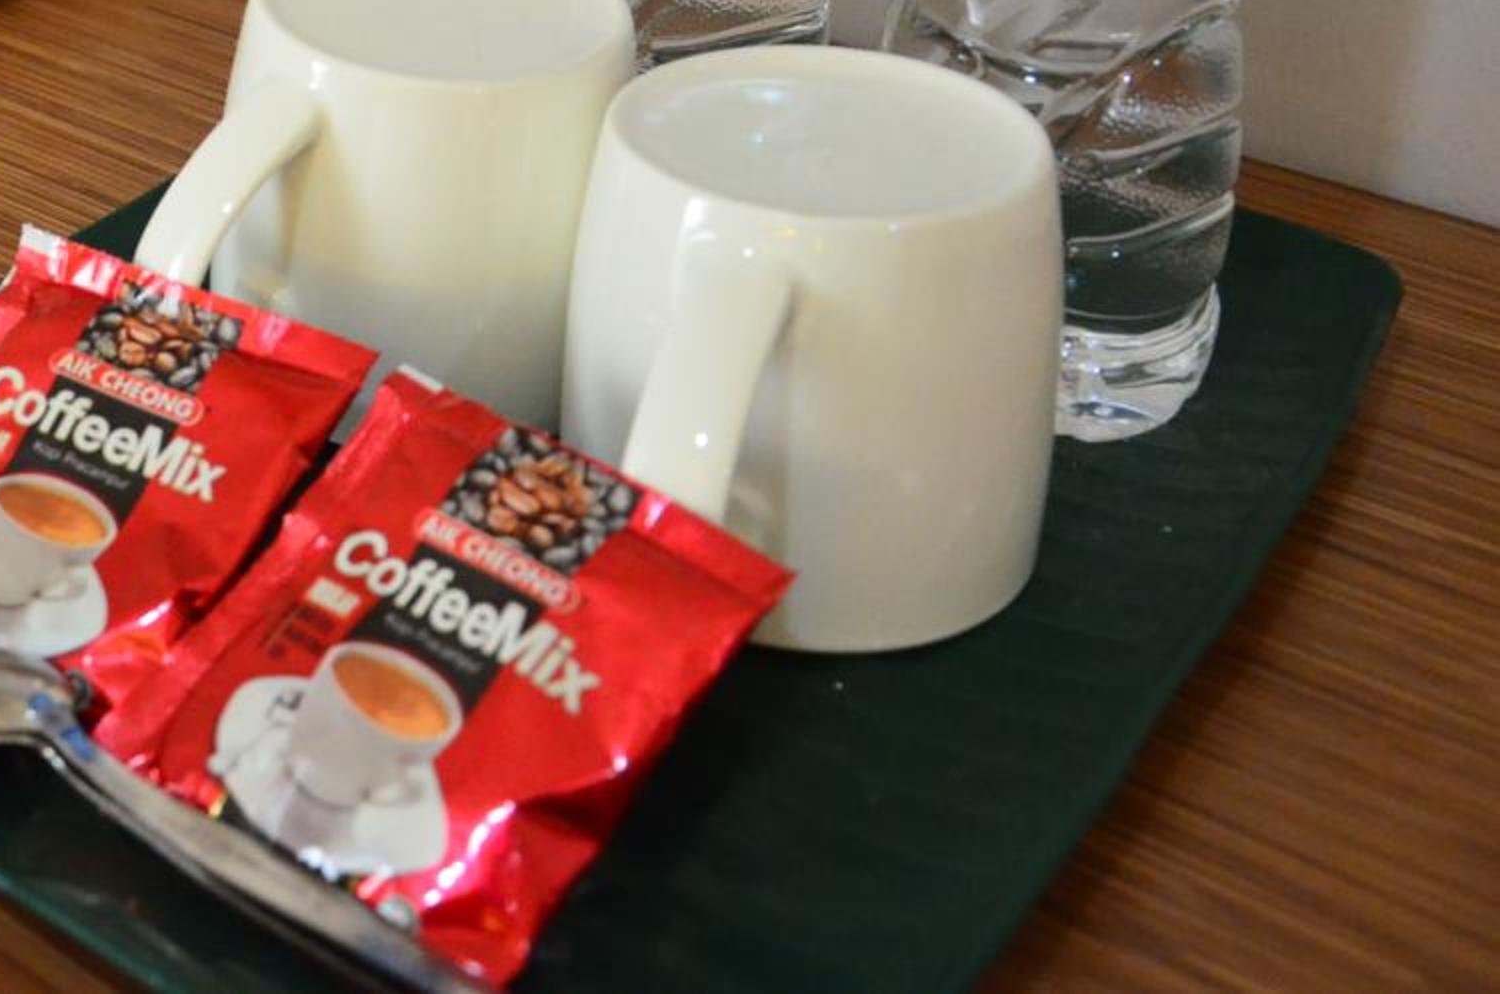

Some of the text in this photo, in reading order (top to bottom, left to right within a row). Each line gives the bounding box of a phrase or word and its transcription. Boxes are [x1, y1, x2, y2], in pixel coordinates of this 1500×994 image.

[56, 352, 197, 420] AIK CHEONG
[333, 529, 602, 716] CoffeeMix
